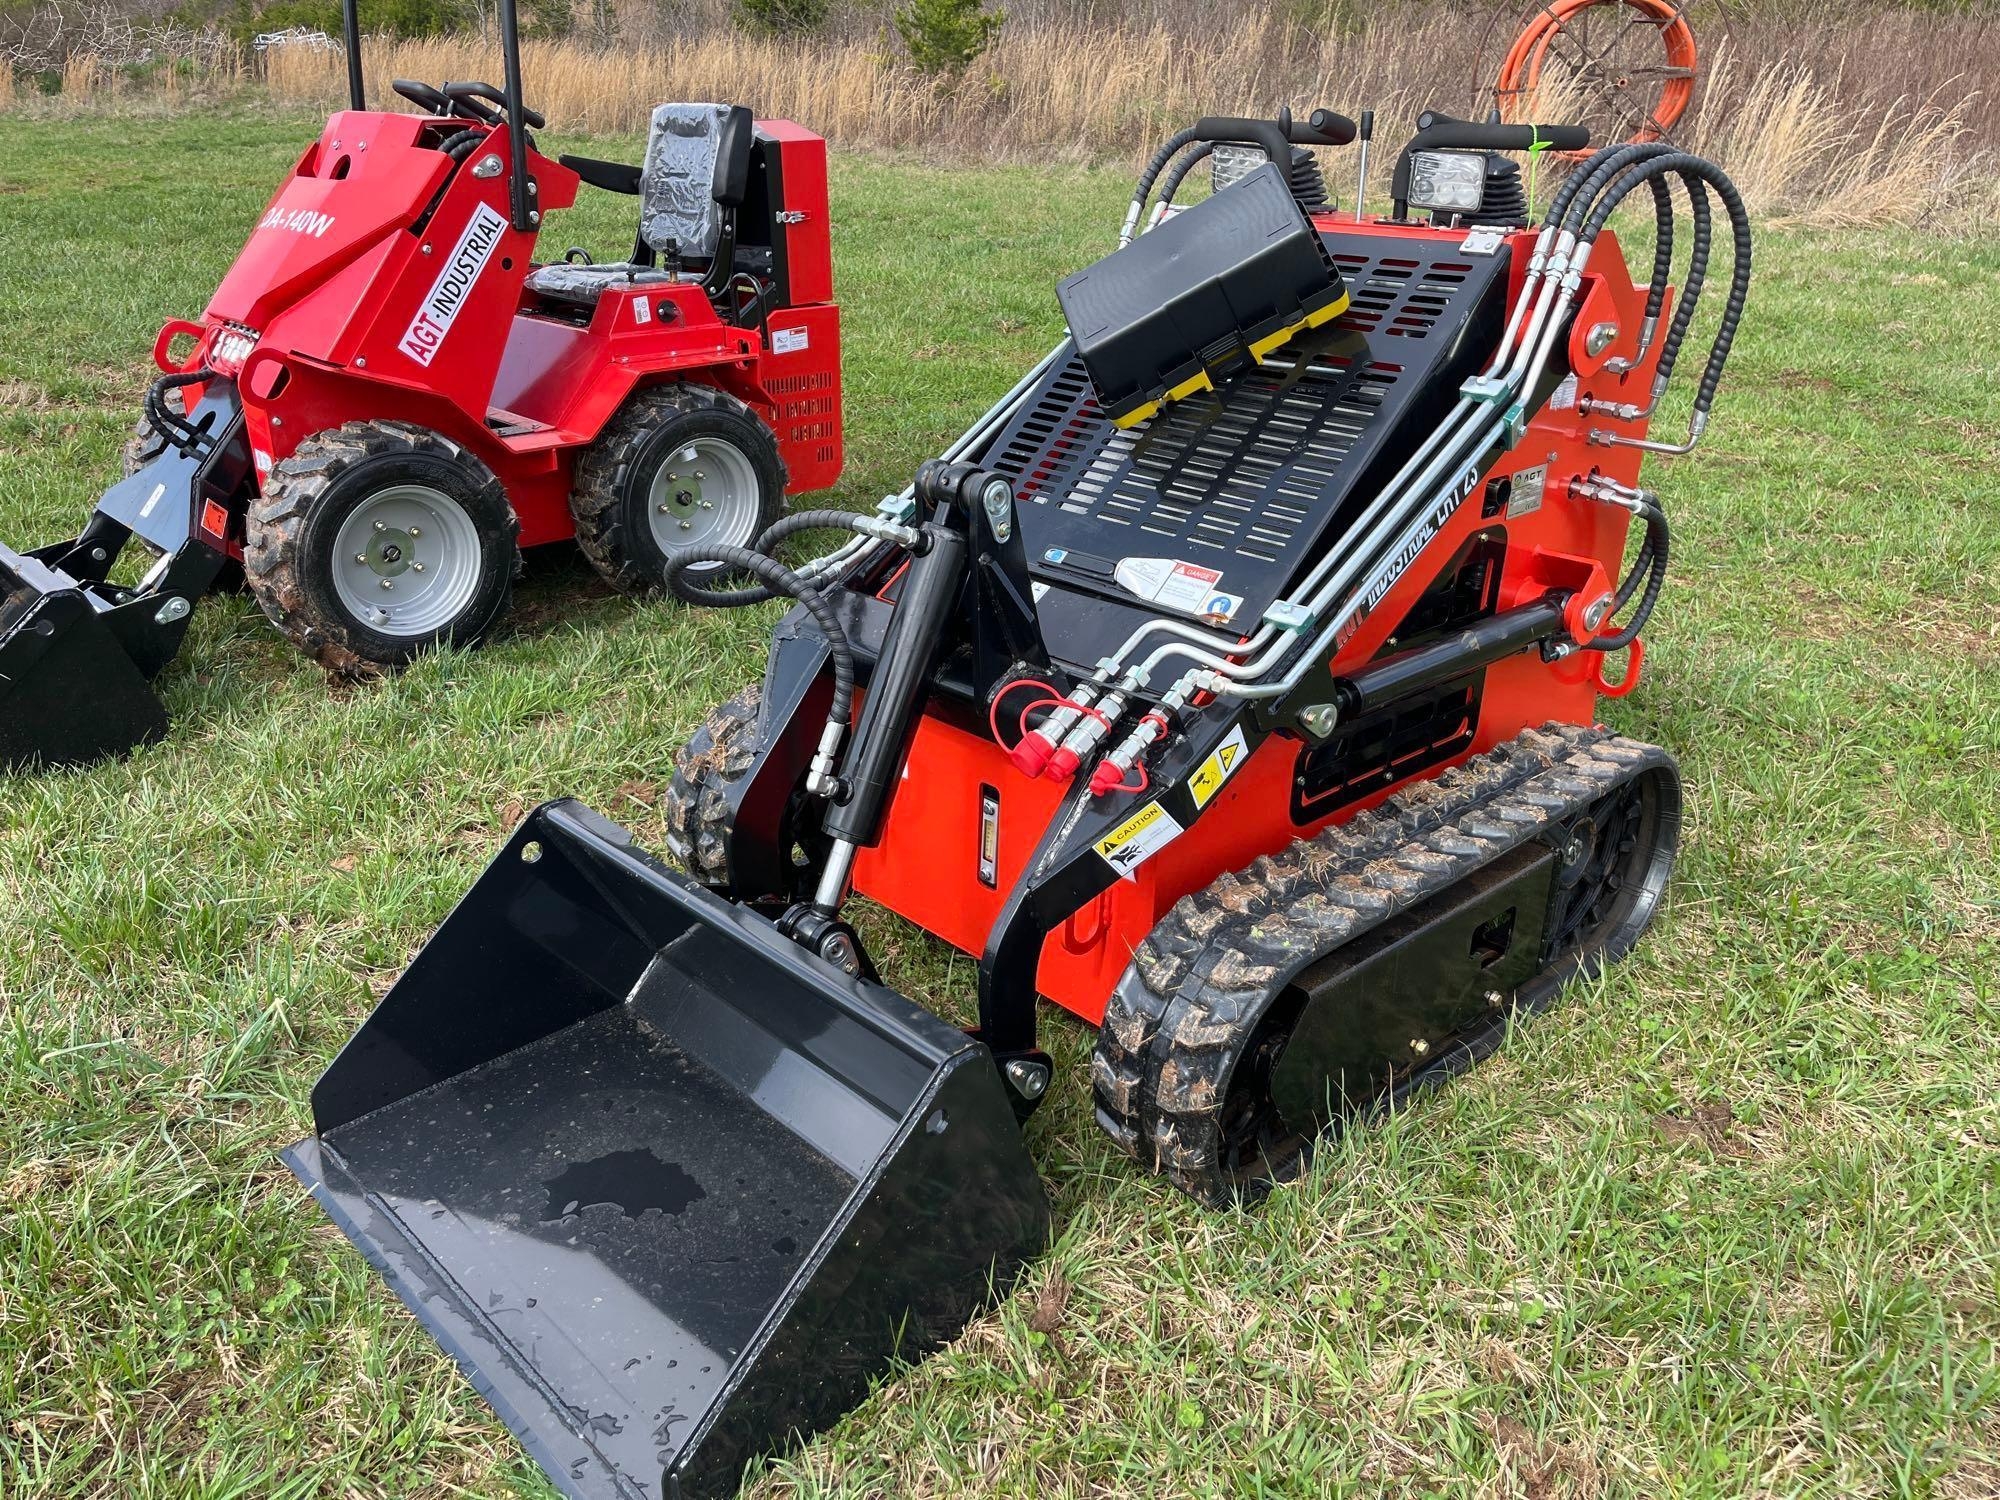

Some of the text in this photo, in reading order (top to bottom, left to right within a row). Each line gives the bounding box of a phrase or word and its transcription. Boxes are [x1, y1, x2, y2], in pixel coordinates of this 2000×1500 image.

[405, 214, 501, 363] AGT INDUSTRIAL
[1523, 469, 1543, 483] AGT
[1116, 808, 1158, 840] CAUTION
